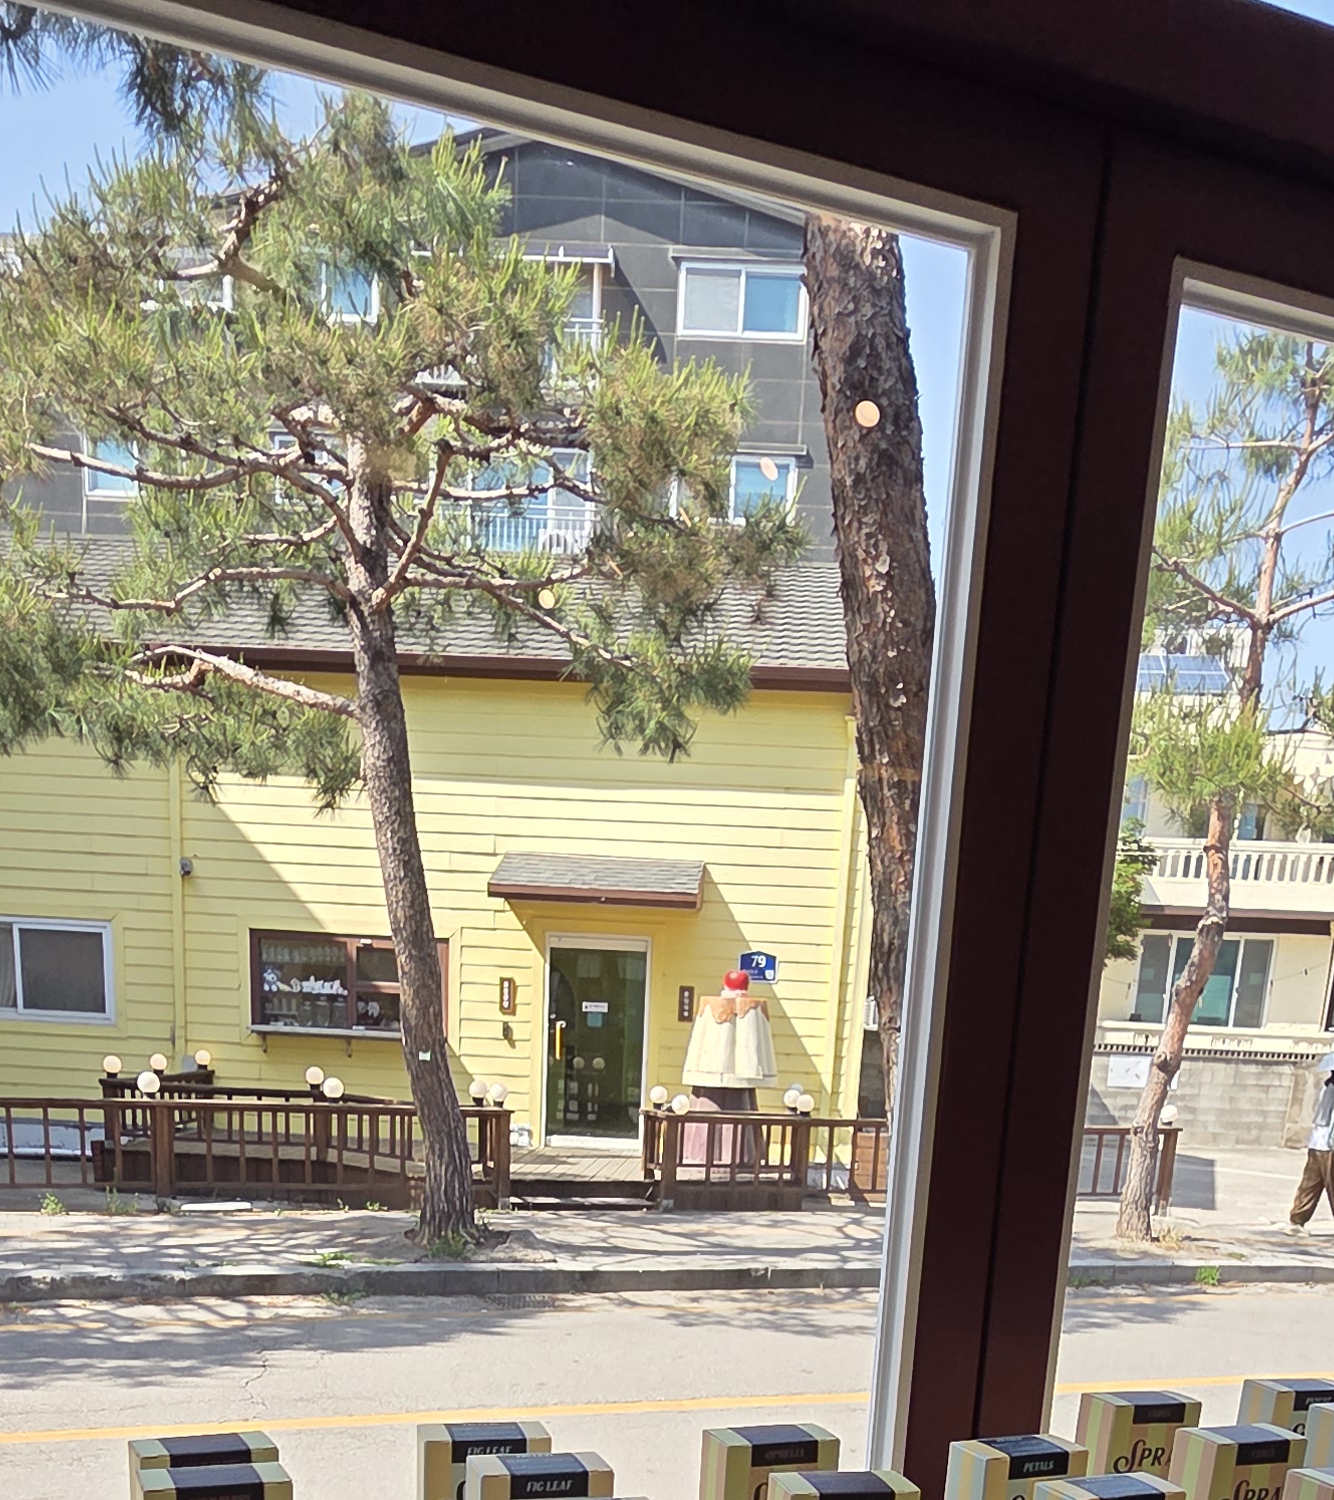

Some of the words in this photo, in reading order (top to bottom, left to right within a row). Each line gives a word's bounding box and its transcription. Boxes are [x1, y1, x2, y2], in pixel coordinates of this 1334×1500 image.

[750, 955, 767, 968] 79
[526, 1481, 544, 1493] FIG
[546, 1480, 574, 1492] LEAF
